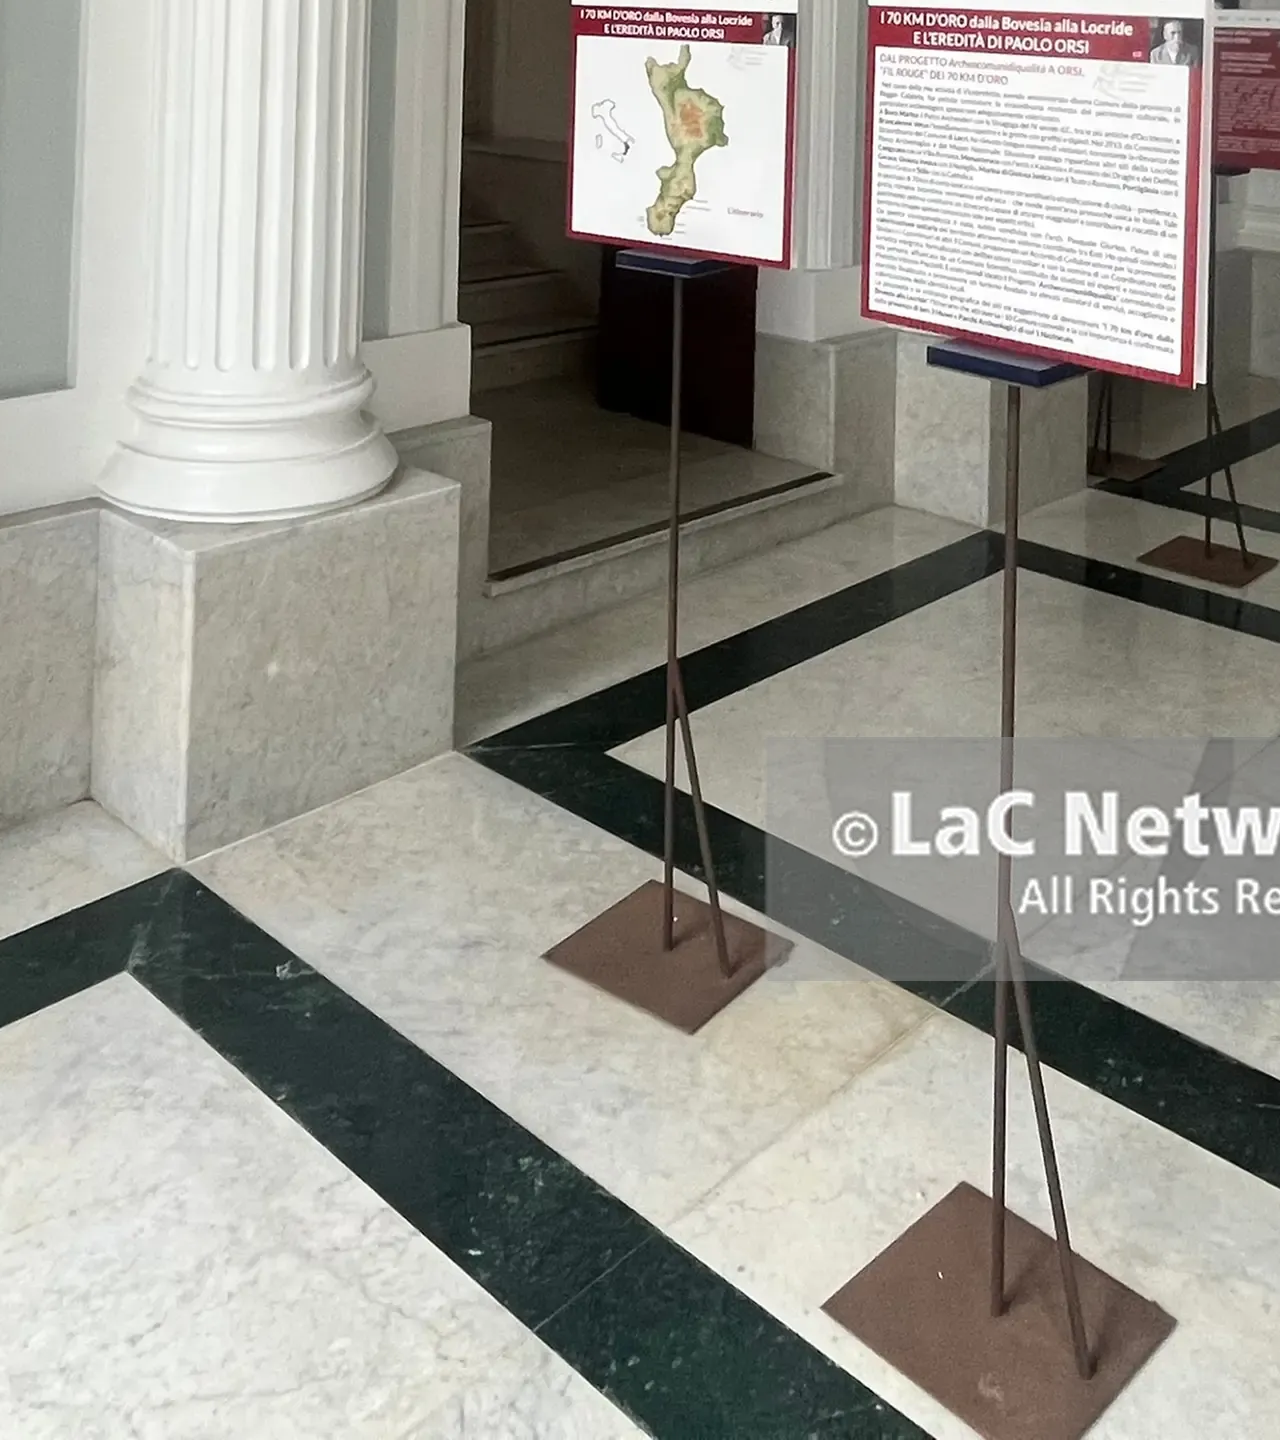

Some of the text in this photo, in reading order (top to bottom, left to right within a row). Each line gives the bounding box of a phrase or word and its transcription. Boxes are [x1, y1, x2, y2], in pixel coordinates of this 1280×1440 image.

[885, 10, 902, 26] 70
[902, 11, 925, 27] KM
[968, 14, 1000, 30] dalla
[1000, 15, 1052, 33] Bovesia
[1052, 17, 1079, 34] alla
[1080, 19, 1134, 37] Locride
[912, 30, 1090, 55] E L'EREDITÀ DI PAOLO ORSI
